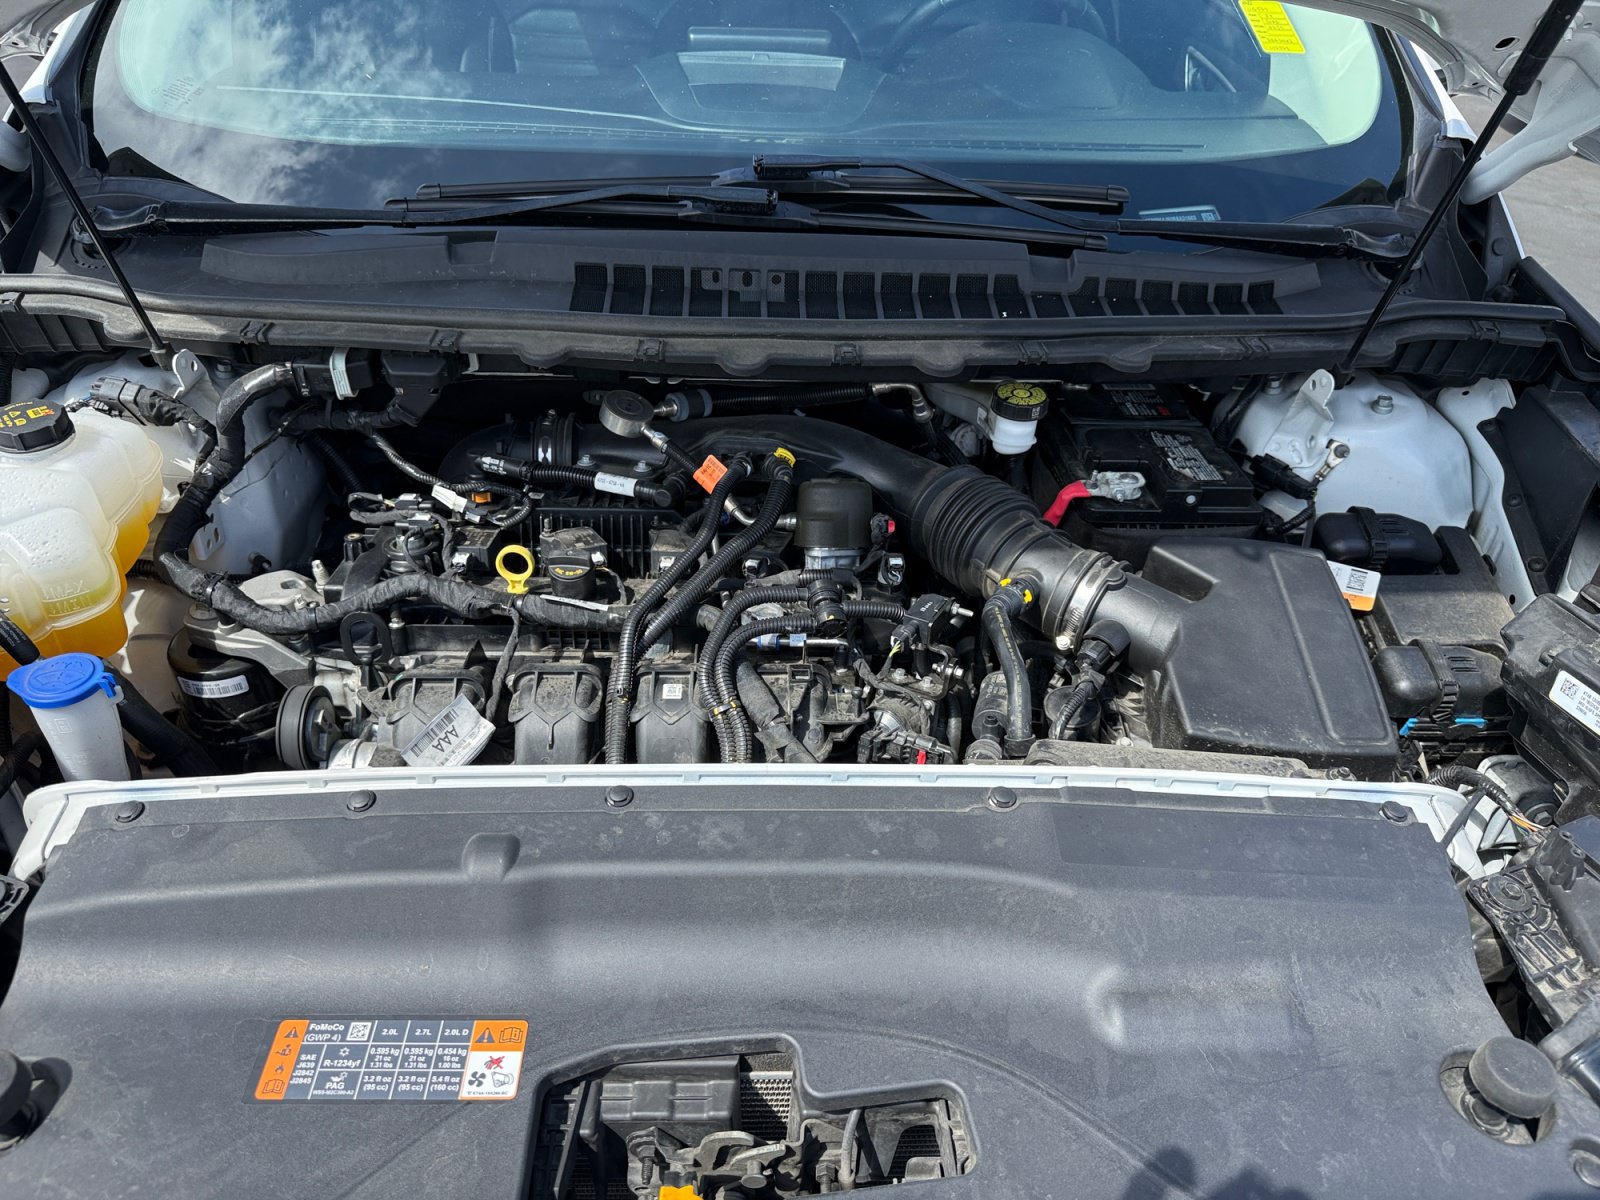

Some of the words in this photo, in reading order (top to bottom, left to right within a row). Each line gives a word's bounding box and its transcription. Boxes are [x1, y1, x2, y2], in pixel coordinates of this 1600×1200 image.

[432, 725, 459, 753] AAA
[309, 1023, 345, 1031] FoMoCo
[382, 1028, 399, 1036] 2.0L
[415, 1028, 432, 1036] 2.7L
[444, 1028, 461, 1036] 2.0L
[462, 1028, 469, 1036] D
[304, 1033, 331, 1042] (GWP
[331, 1033, 342, 1042] 4)
[370, 1047, 390, 1055] 0.595
[390, 1047, 400, 1056] kg
[404, 1047, 424, 1055] 0.595
[424, 1047, 434, 1056] kg
[437, 1047, 457, 1055] 0.454
[458, 1047, 467, 1056] kg
[323, 1059, 361, 1068] R-1234yf
[325, 1082, 345, 1090] PAG
[363, 1084, 376, 1092] (95
[376, 1084, 389, 1092] cc)
[398, 1084, 411, 1092] (95
[411, 1084, 423, 1092] cc)
[430, 1084, 446, 1092] (160
[446, 1084, 459, 1092] cc)
